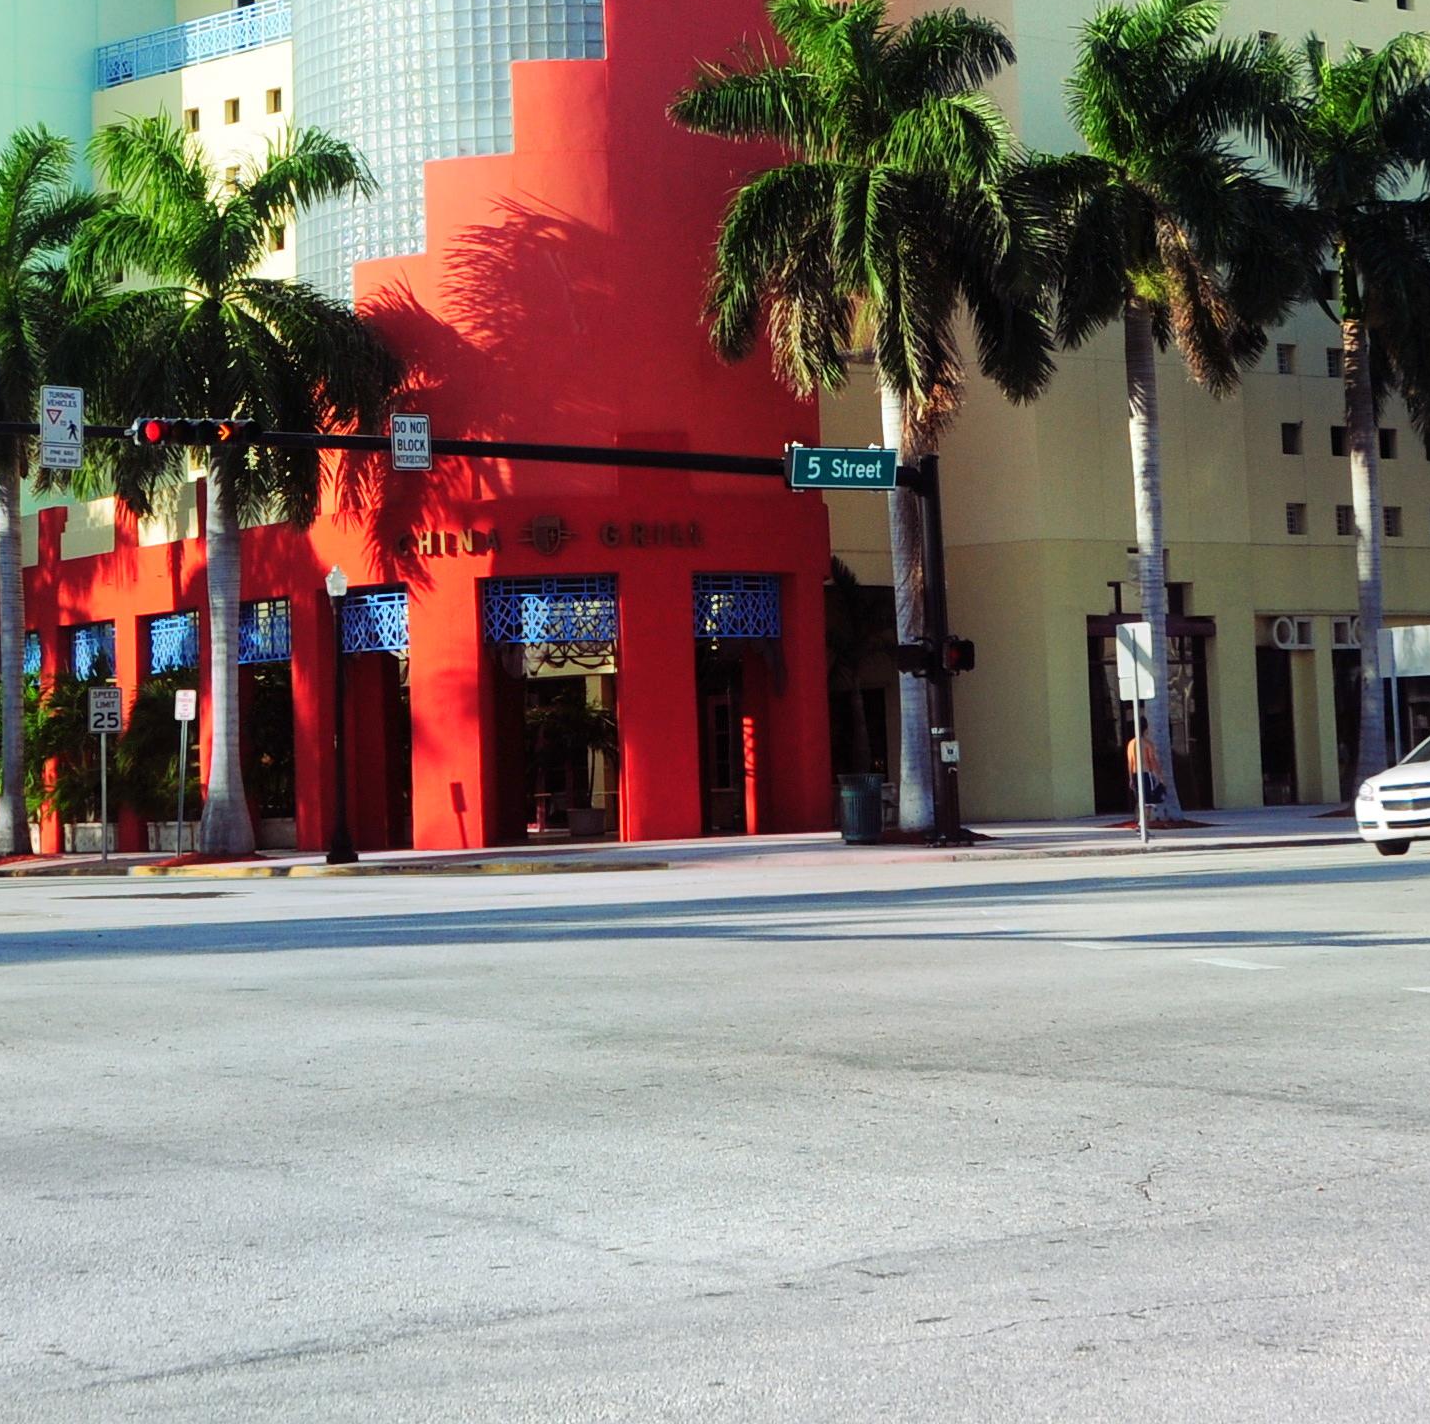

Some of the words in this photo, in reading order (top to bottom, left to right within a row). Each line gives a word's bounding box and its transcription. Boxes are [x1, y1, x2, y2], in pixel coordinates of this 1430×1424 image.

[48, 391, 76, 400] TURNING
[47, 399, 78, 408] VEHICLES
[394, 421, 407, 433] DO
[410, 421, 427, 434] NOT
[397, 439, 427, 452] BLOCK
[807, 456, 821, 479] 5
[831, 458, 882, 479] Street
[397, 529, 501, 556] CHINA
[601, 522, 704, 548] GRILL
[95, 700, 116, 709] LIMIT
[93, 712, 119, 729] 25
